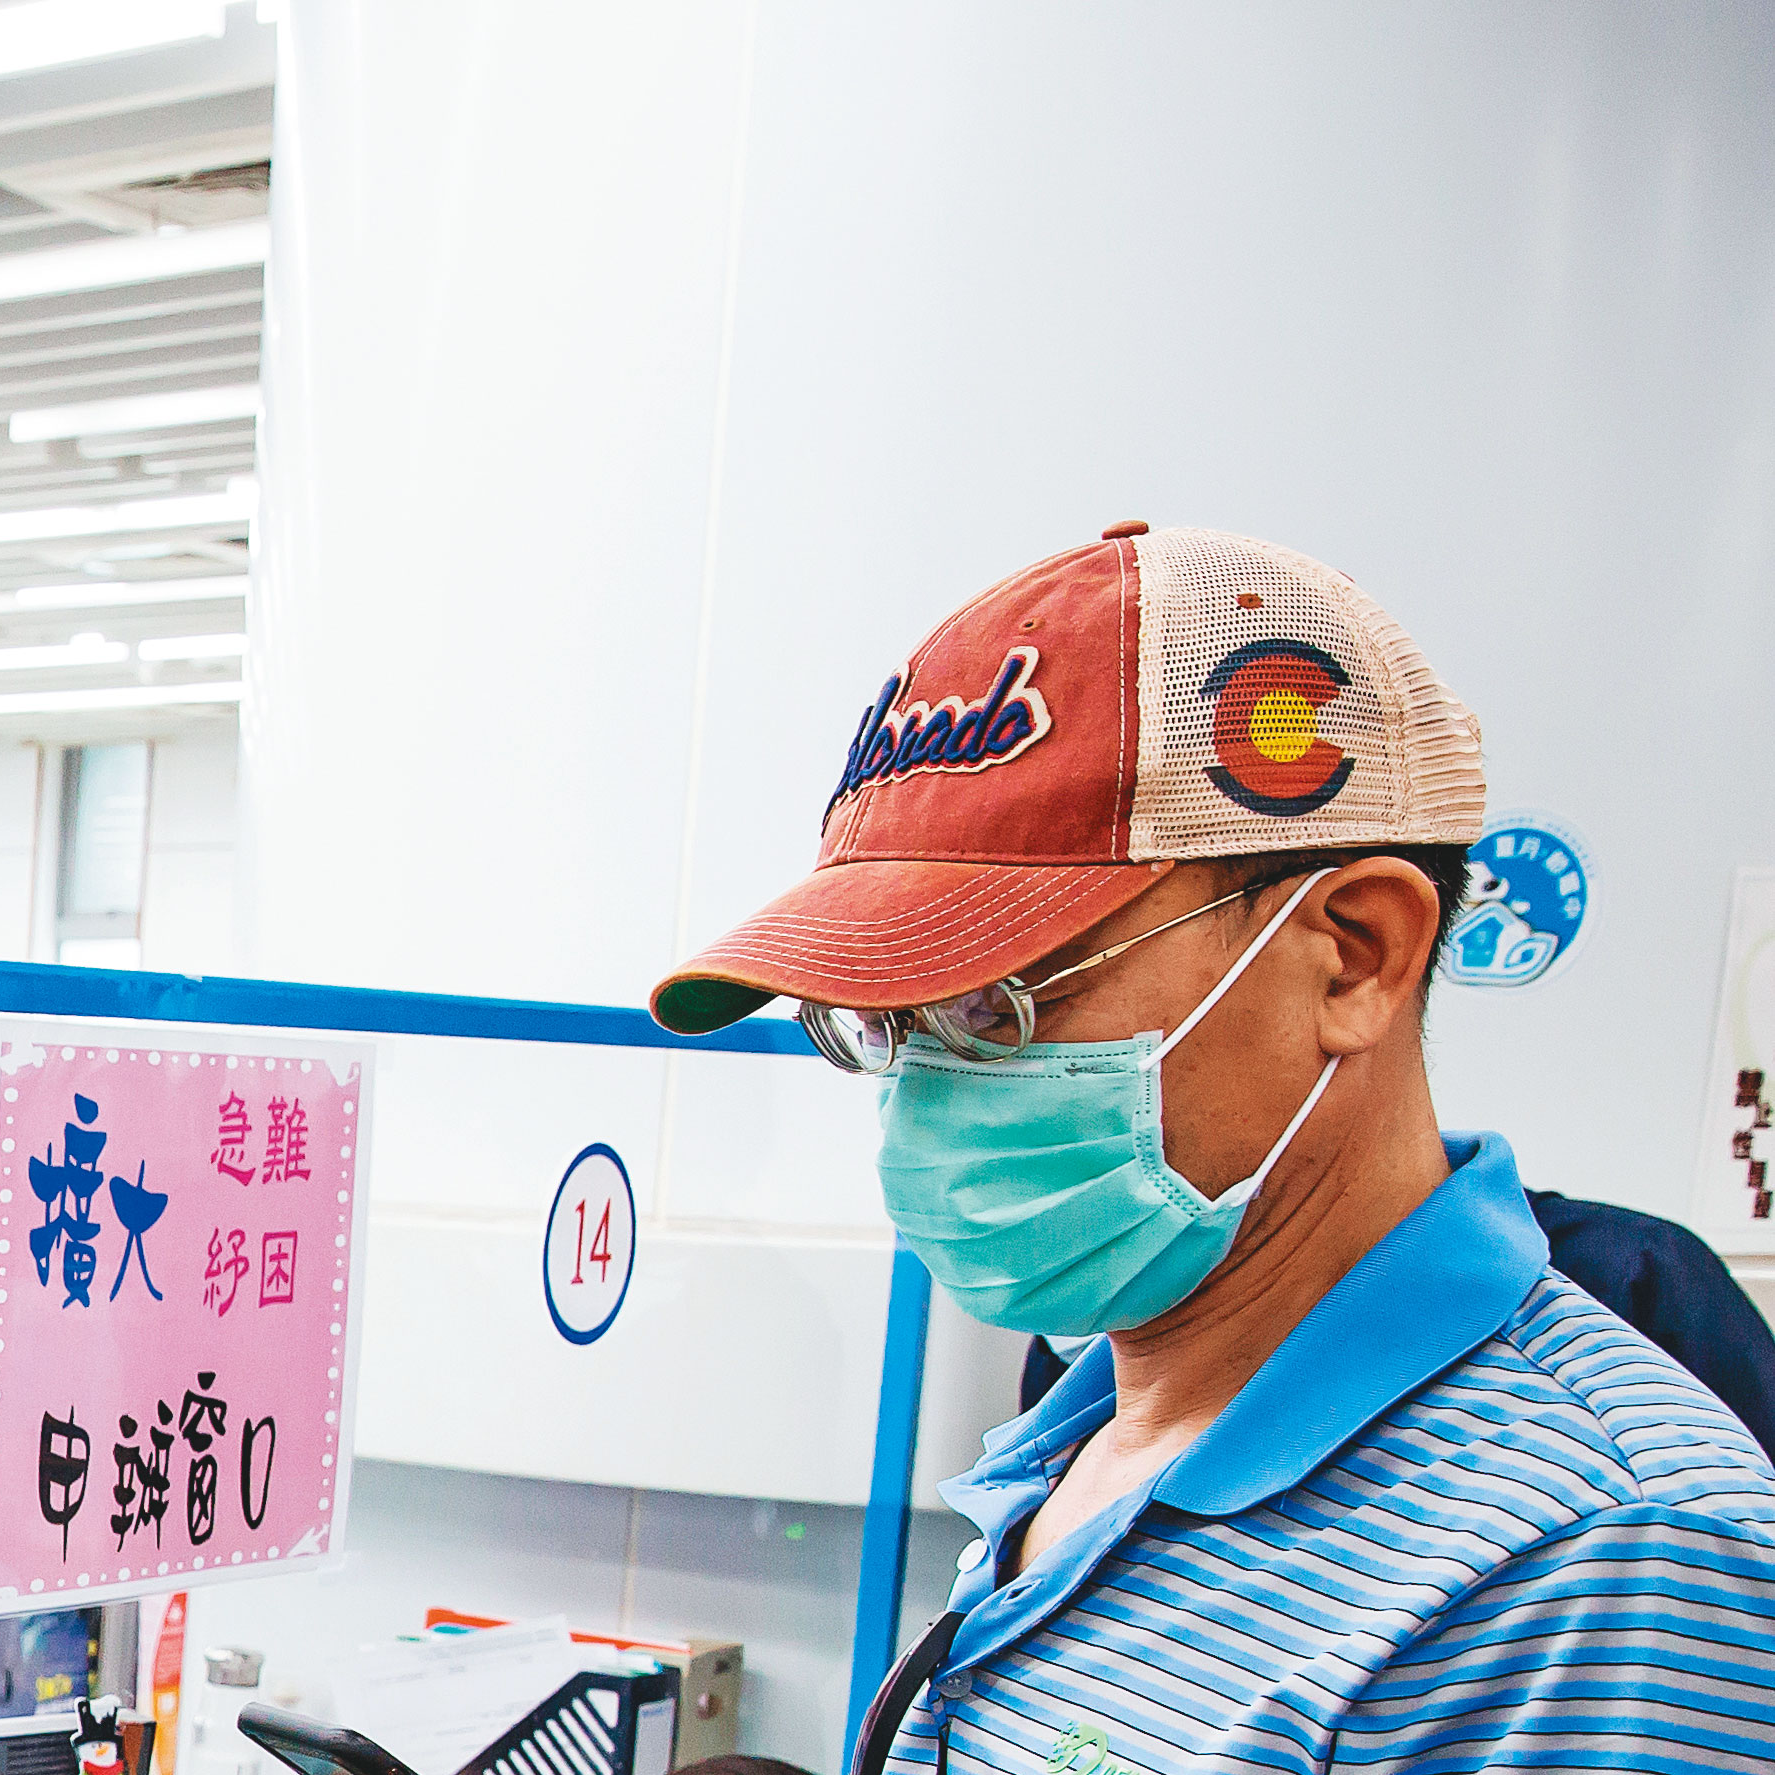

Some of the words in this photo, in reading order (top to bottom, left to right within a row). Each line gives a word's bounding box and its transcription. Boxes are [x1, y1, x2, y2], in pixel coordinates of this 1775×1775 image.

[211, 1091, 311, 1187] 急難
[29, 1094, 168, 1308] 擴大
[571, 1198, 612, 1285] 14
[203, 1226, 298, 1318] 紓困
